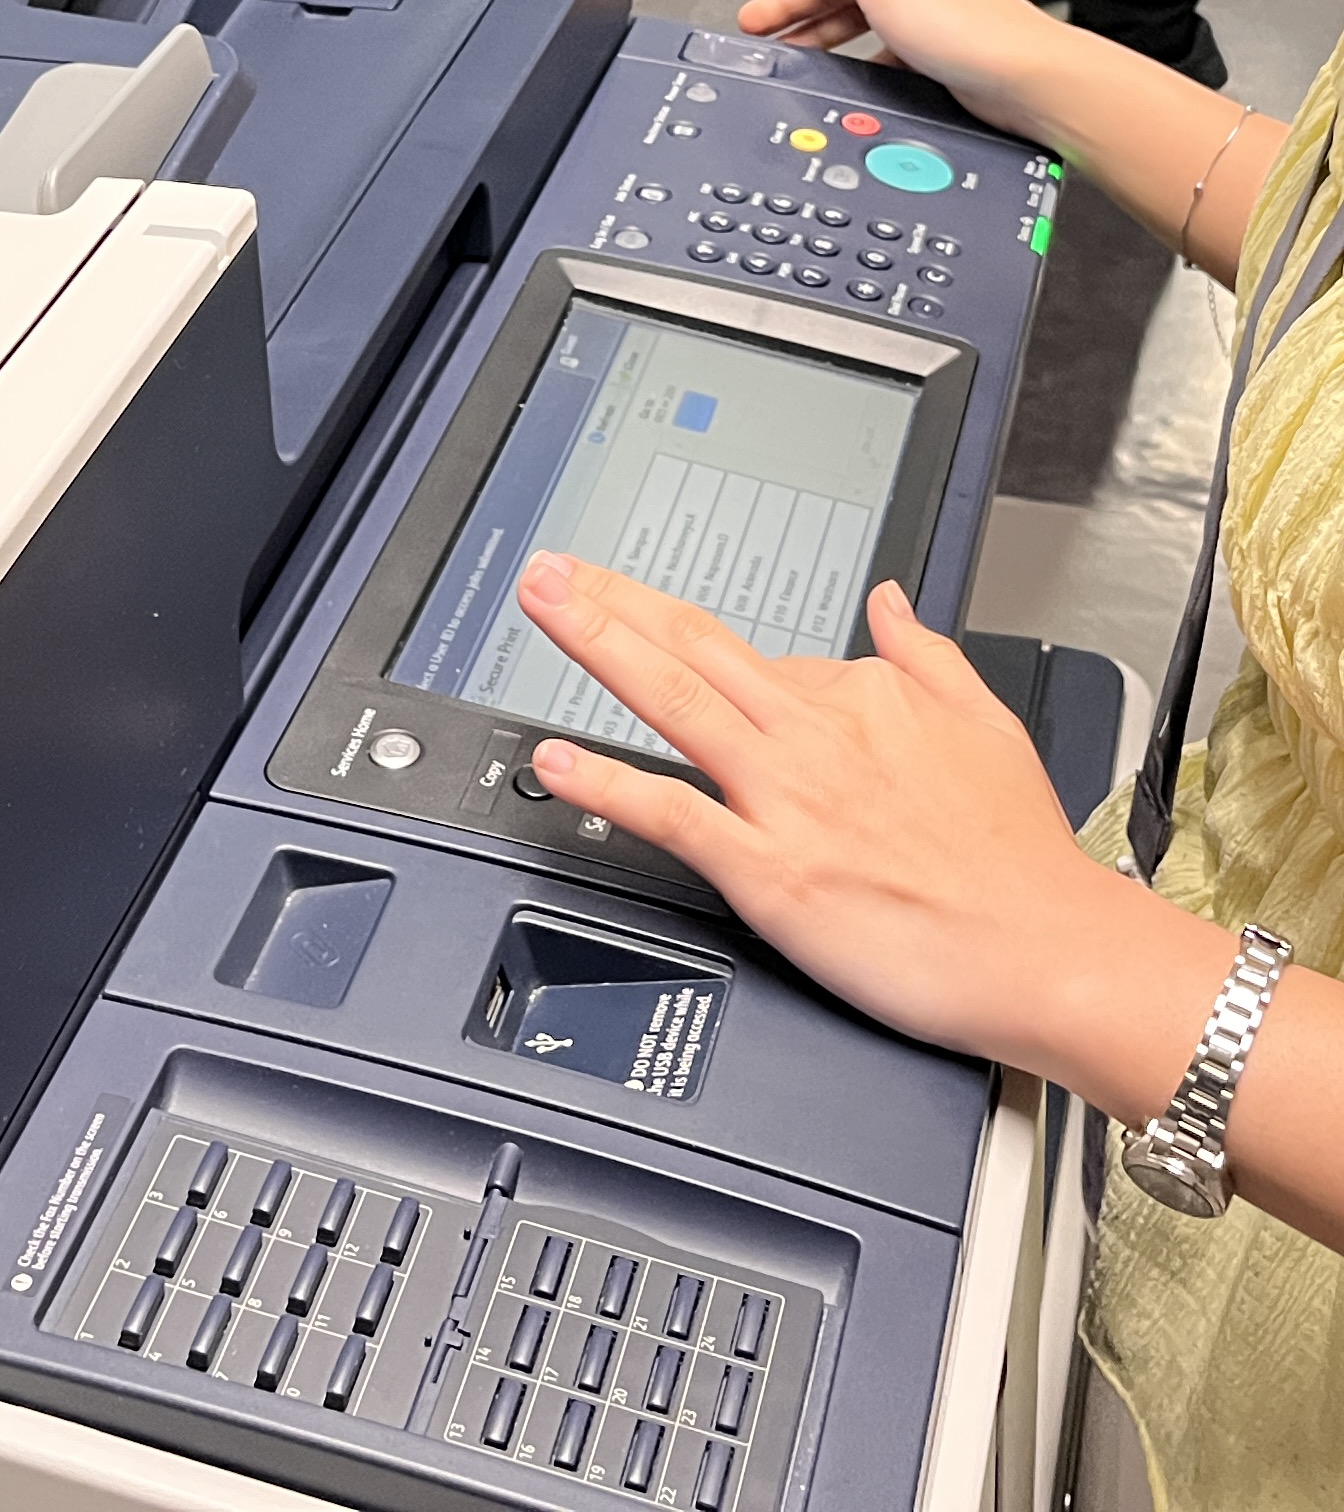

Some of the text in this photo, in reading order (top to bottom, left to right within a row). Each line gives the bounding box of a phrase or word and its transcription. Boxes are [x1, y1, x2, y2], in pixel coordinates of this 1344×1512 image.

[709, 215, 729, 227] 2
[760, 227, 780, 237] 5
[803, 269, 822, 280] 7
[454, 589, 475, 618] access
[446, 618, 461, 629] to
[811, 614, 826, 633] 012
[439, 628, 455, 641] ID
[429, 642, 449, 664] User
[476, 624, 522, 694] Secure Print
[330, 708, 376, 777] Services Home
[479, 760, 506, 787] Copy
[584, 816, 607, 832] Se
[673, 987, 694, 1016] while
[630, 993, 672, 1078] DO NOT remove
[660, 1014, 685, 1051] device
[666, 993, 713, 1098] it is being accessed.
[651, 1051, 673, 1077] USB
[17, 1113, 105, 1267] Check the Fax Number on the screen
[149, 1190, 164, 1201] 3
[31, 1148, 103, 1270] before starting transmission.
[213, 1210, 228, 1220] 6
[278, 1227, 292, 1238] 9
[343, 1243, 360, 1257] 12
[115, 1258, 131, 1270] 2
[182, 1278, 196, 1288] 5
[500, 1275, 516, 1289] 15
[247, 1297, 262, 1308] 8
[567, 1294, 583, 1309] 18
[314, 1313, 331, 1328] 11
[633, 1316, 649, 1331] 21
[80, 1331, 94, 1340] 1
[701, 1335, 716, 1351] 24
[148, 1350, 163, 1362] 4
[475, 1346, 492, 1362] 14
[215, 1371, 229, 1381] 7
[543, 1366, 559, 1382] 17
[286, 1386, 301, 1397] 0
[611, 1387, 629, 1405] 20
[681, 1408, 697, 1425] 23
[448, 1422, 466, 1438] 13
[518, 1443, 536, 1459] 16
[589, 1465, 606, 1481] 19
[659, 1486, 677, 1505] 22
